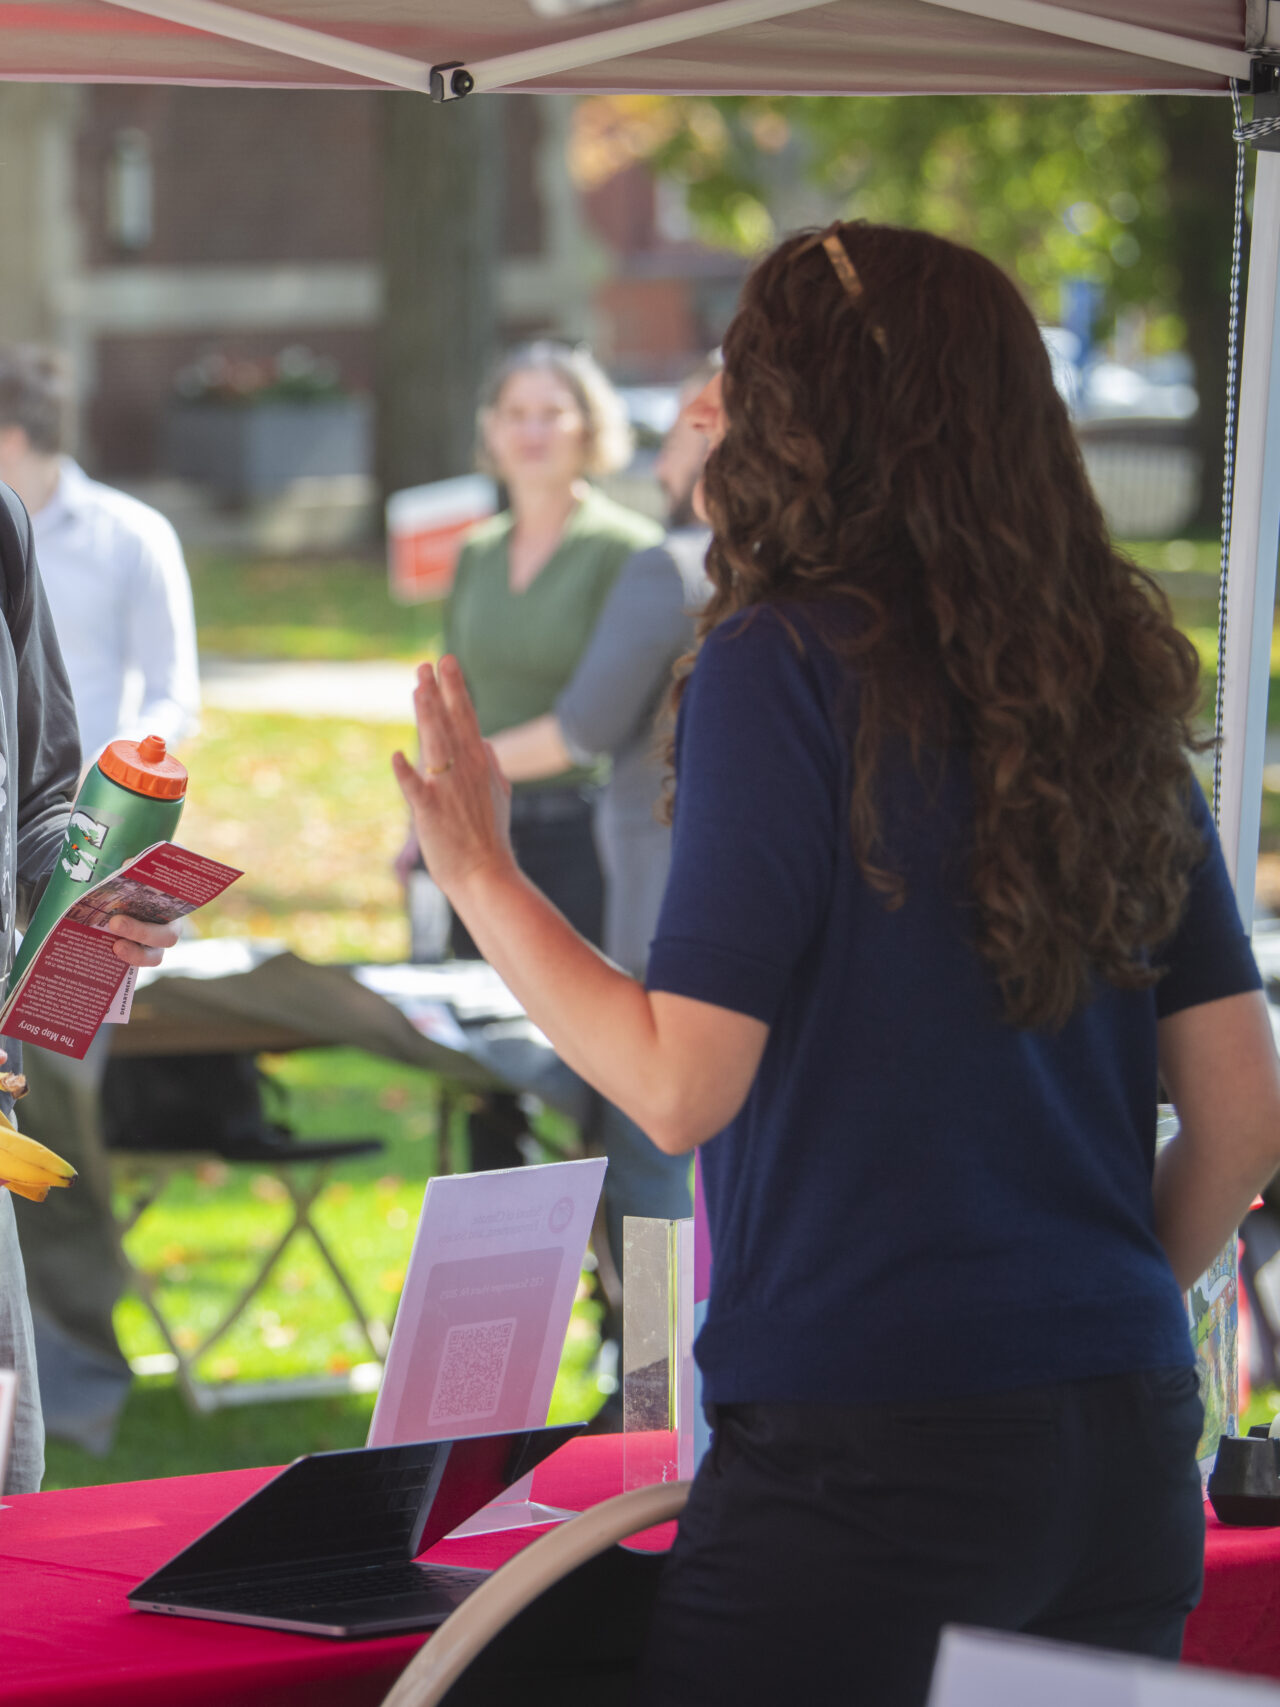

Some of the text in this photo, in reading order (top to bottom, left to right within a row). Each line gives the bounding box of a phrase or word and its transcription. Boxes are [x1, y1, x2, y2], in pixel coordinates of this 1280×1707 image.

[119, 976, 131, 1015] DEPARTMENT
[17, 1020, 74, 1048] The Map Story
